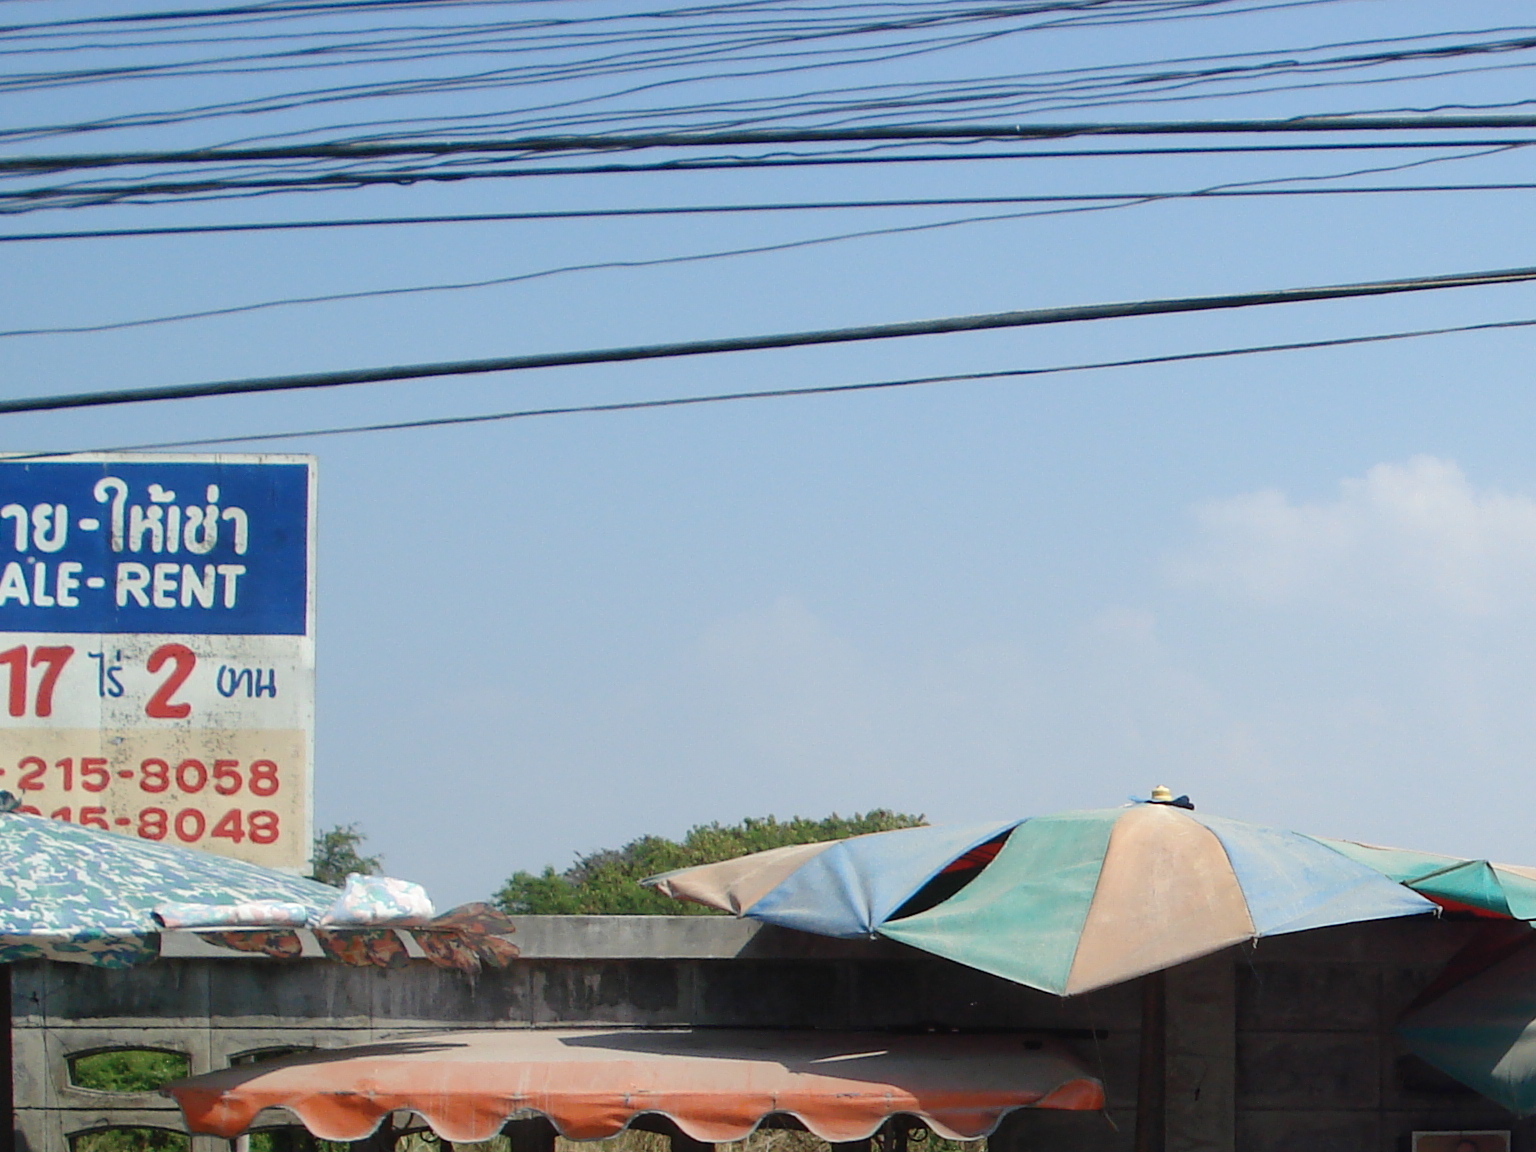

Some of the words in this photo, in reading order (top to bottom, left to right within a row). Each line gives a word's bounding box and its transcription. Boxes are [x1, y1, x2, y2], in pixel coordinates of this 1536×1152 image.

[0, 644, 75, 718] 17
[87, 649, 126, 698] ไร่
[145, 643, 197, 719] 2
